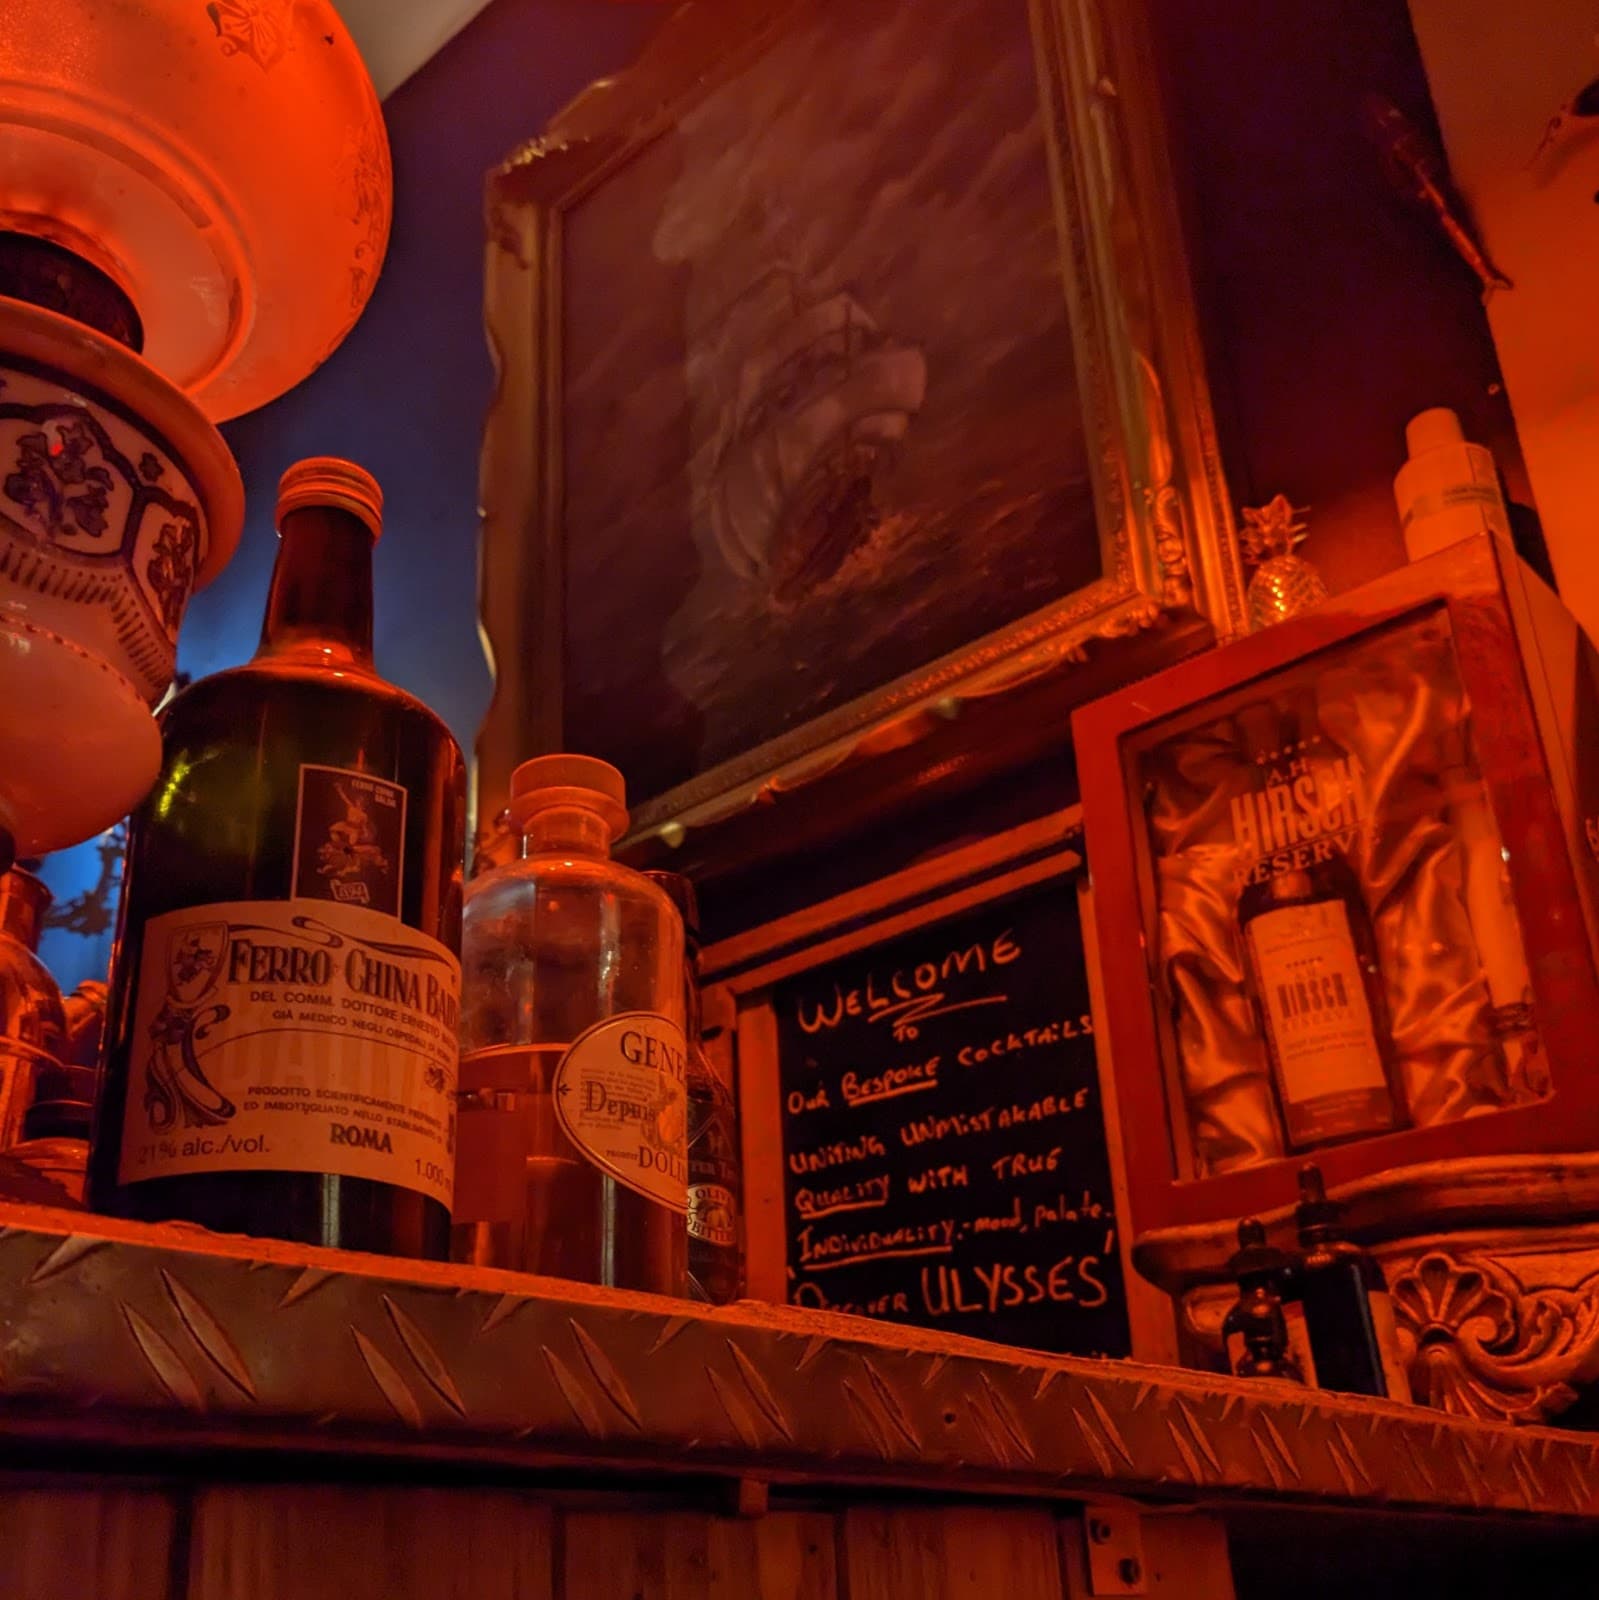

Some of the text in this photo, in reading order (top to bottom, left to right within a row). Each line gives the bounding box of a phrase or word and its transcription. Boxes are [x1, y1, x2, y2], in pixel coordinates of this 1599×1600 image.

[1230, 753, 1366, 858] HIRSCH
[228, 939, 332, 987] FERRO
[344, 948, 422, 1012] CHINA
[799, 928, 1023, 1034] WELCOME
[249, 990, 277, 1003] DEL
[341, 997, 399, 1022] DOTTORE
[298, 1011, 348, 1027] MEDICO
[247, 1085, 311, 1098] PRODOTTO
[841, 1056, 941, 1102] BESPOKE
[353, 1109, 383, 1123] NELLO
[181, 1134, 271, 1157] alc./vol.
[328, 1122, 393, 1154] ROMA
[991, 1146, 1064, 1182] TRUE
